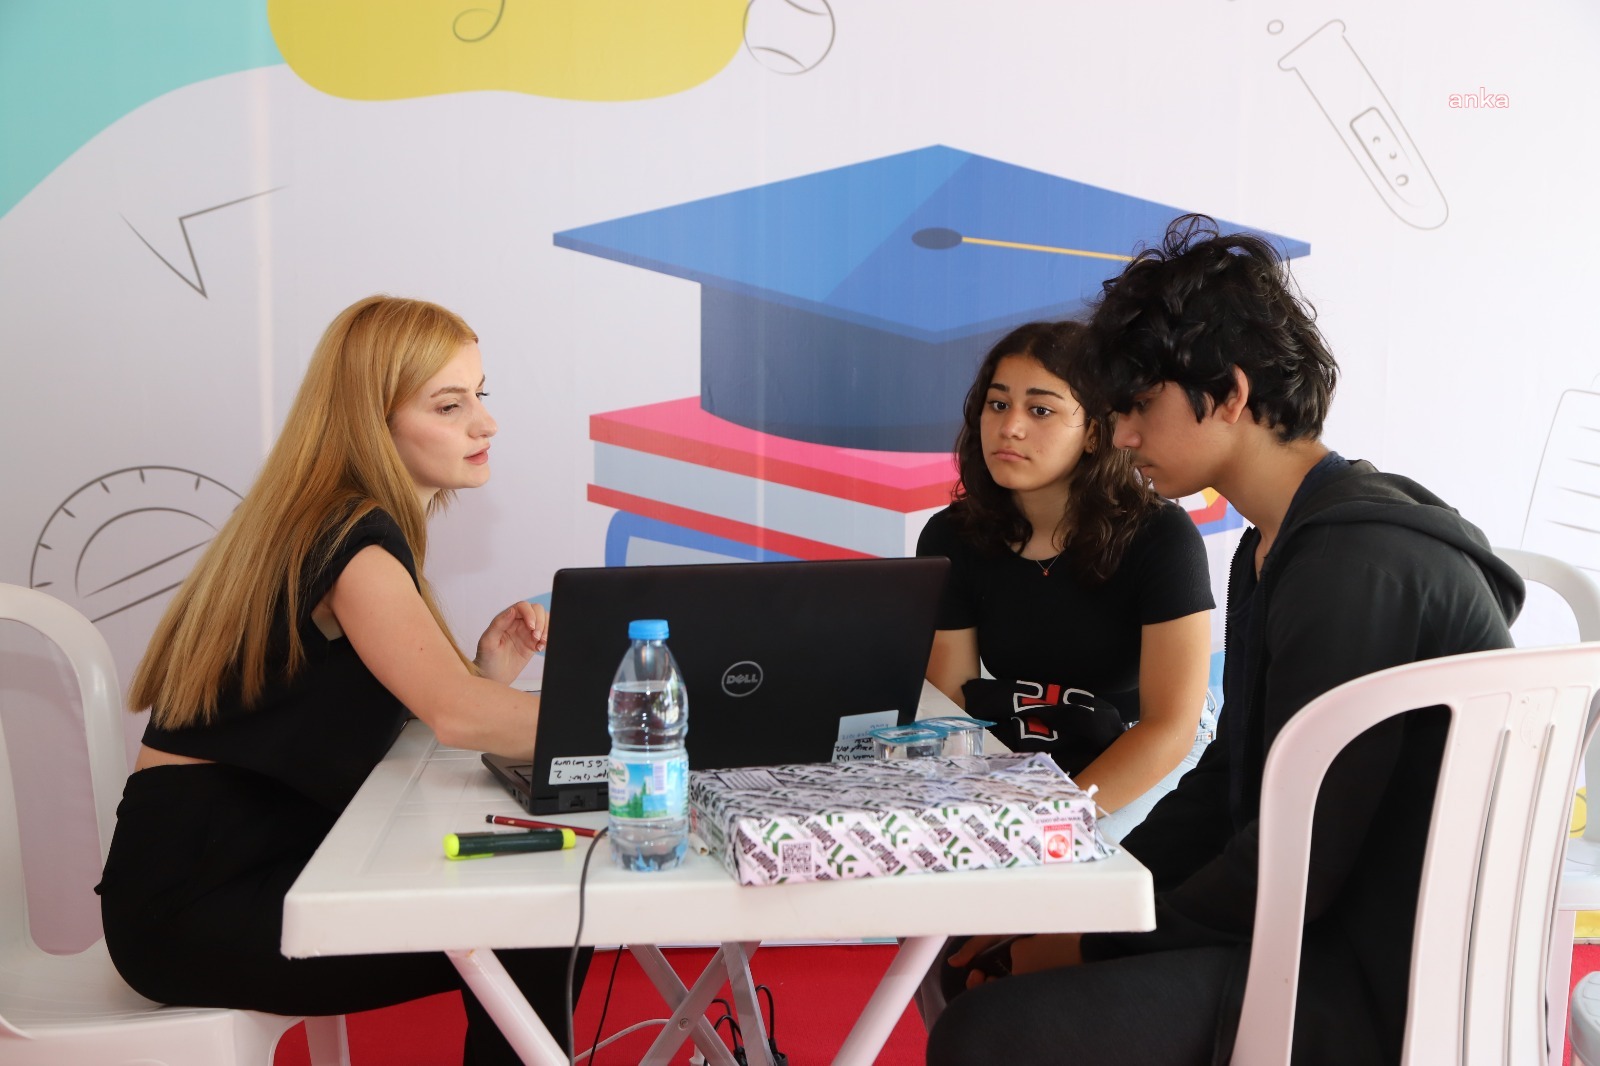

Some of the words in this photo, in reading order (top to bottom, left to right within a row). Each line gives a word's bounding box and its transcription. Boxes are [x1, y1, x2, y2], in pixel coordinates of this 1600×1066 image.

[726, 674, 758, 685] DELL
[806, 821, 837, 851] Copier
[849, 821, 875, 847] Bond
[964, 814, 989, 840] Bond
[871, 842, 900, 872] Copier
[914, 843, 938, 868] Bond
[984, 835, 1013, 864] Copier
[751, 850, 779, 880] Copier
